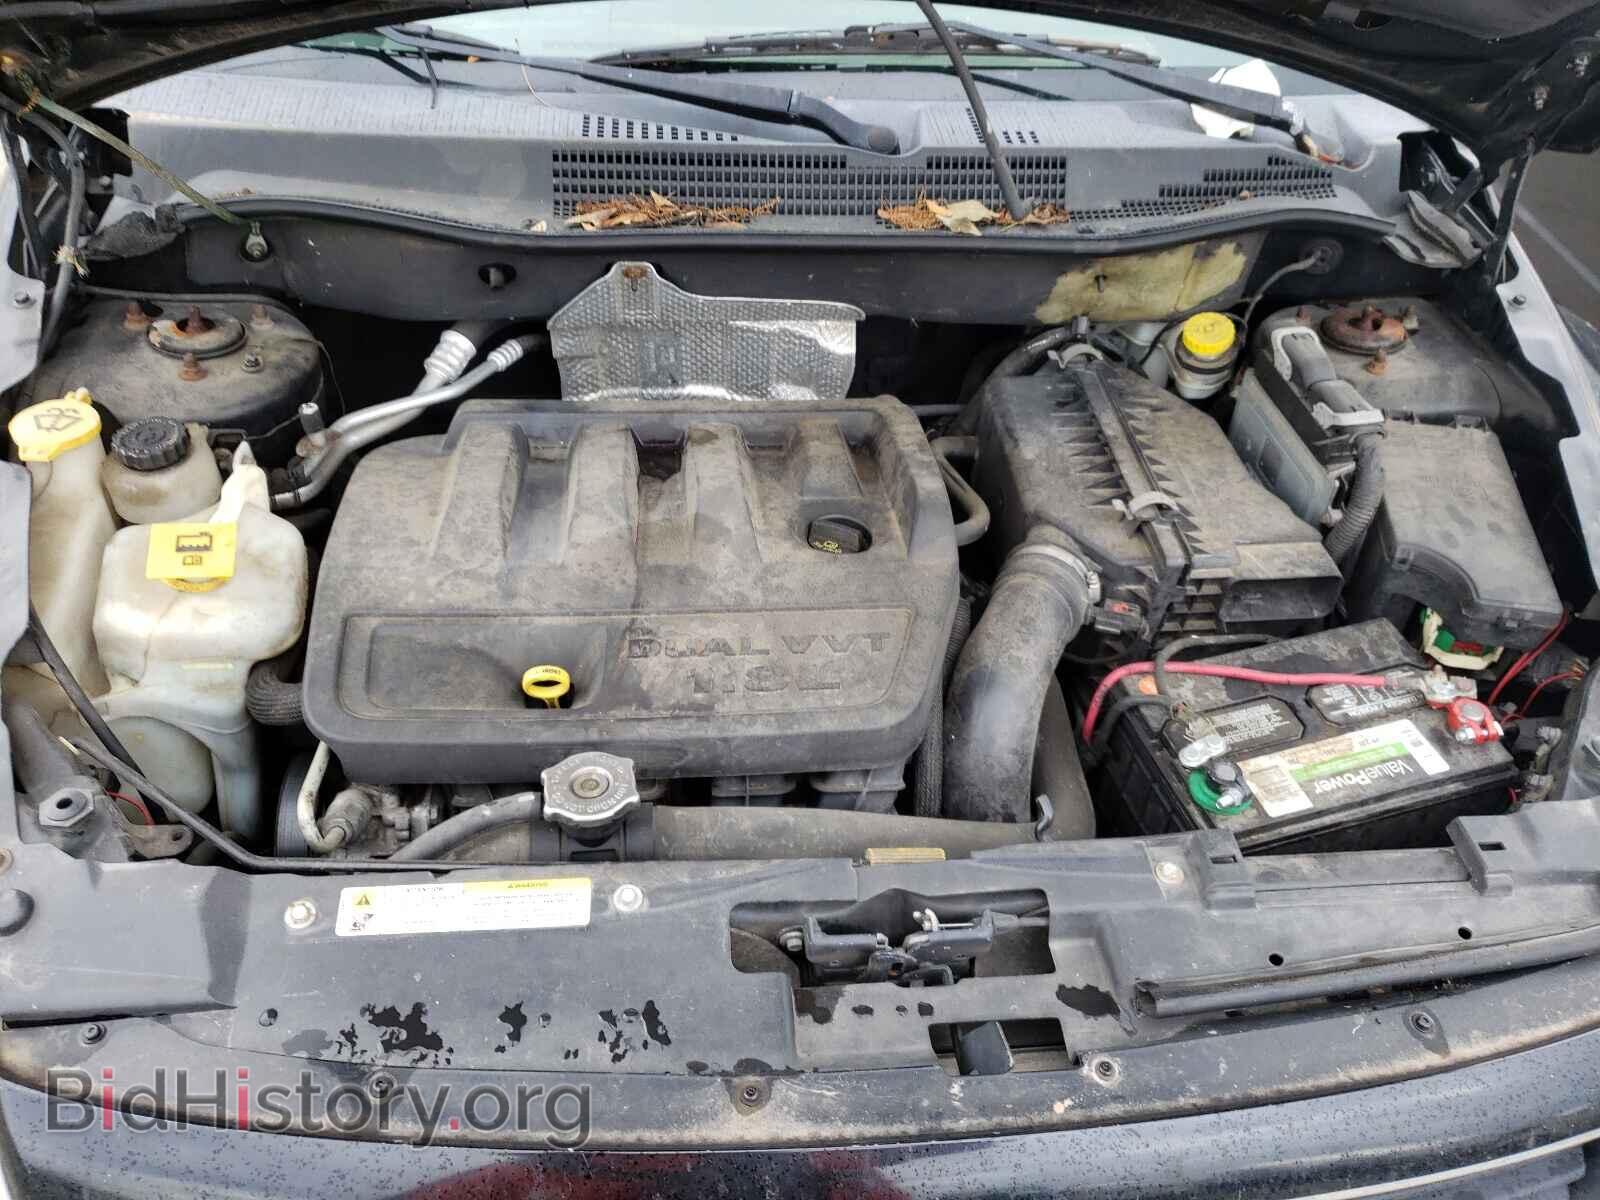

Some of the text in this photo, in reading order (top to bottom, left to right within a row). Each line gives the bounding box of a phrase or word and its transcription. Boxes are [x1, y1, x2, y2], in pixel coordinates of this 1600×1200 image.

[627, 632, 890, 658] DUAL VVT
[1314, 759, 1414, 794] ValuePower
